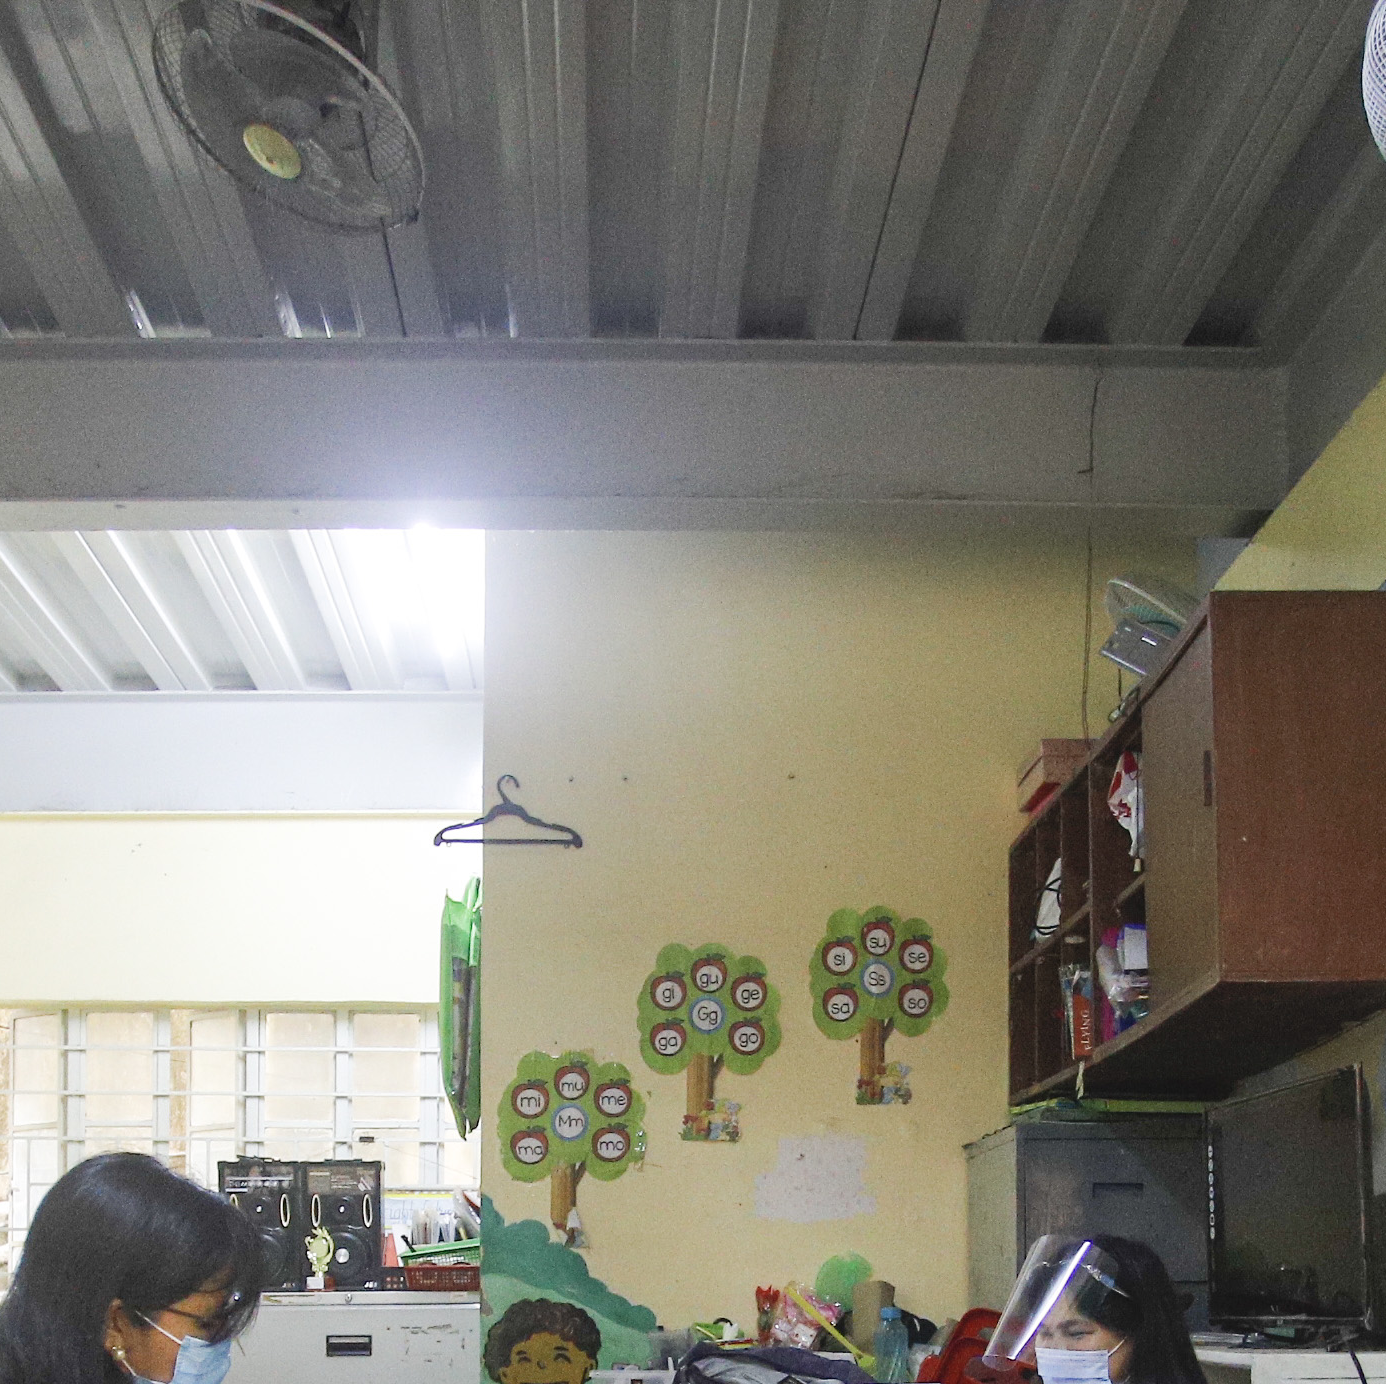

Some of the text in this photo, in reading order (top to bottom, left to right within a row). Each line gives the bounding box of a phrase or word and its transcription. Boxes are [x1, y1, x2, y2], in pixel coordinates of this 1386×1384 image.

[869, 935, 888, 951] su
[834, 950, 846, 967] si
[907, 949, 927, 964] se
[699, 970, 720, 990] gu
[868, 971, 886, 986] Ss
[662, 985, 676, 1004] gi
[740, 985, 761, 1005] ge
[831, 1000, 851, 1016] sa
[907, 996, 927, 1011] so
[697, 1006, 719, 1027] Gg
[657, 1032, 679, 1052] ga
[738, 1030, 760, 1049] go
[560, 1079, 585, 1094] mu
[519, 1093, 542, 1109] mi
[600, 1091, 627, 1107] me
[557, 1114, 585, 1129] Mm
[517, 1142, 544, 1157] ma
[598, 1139, 626, 1153] mo
